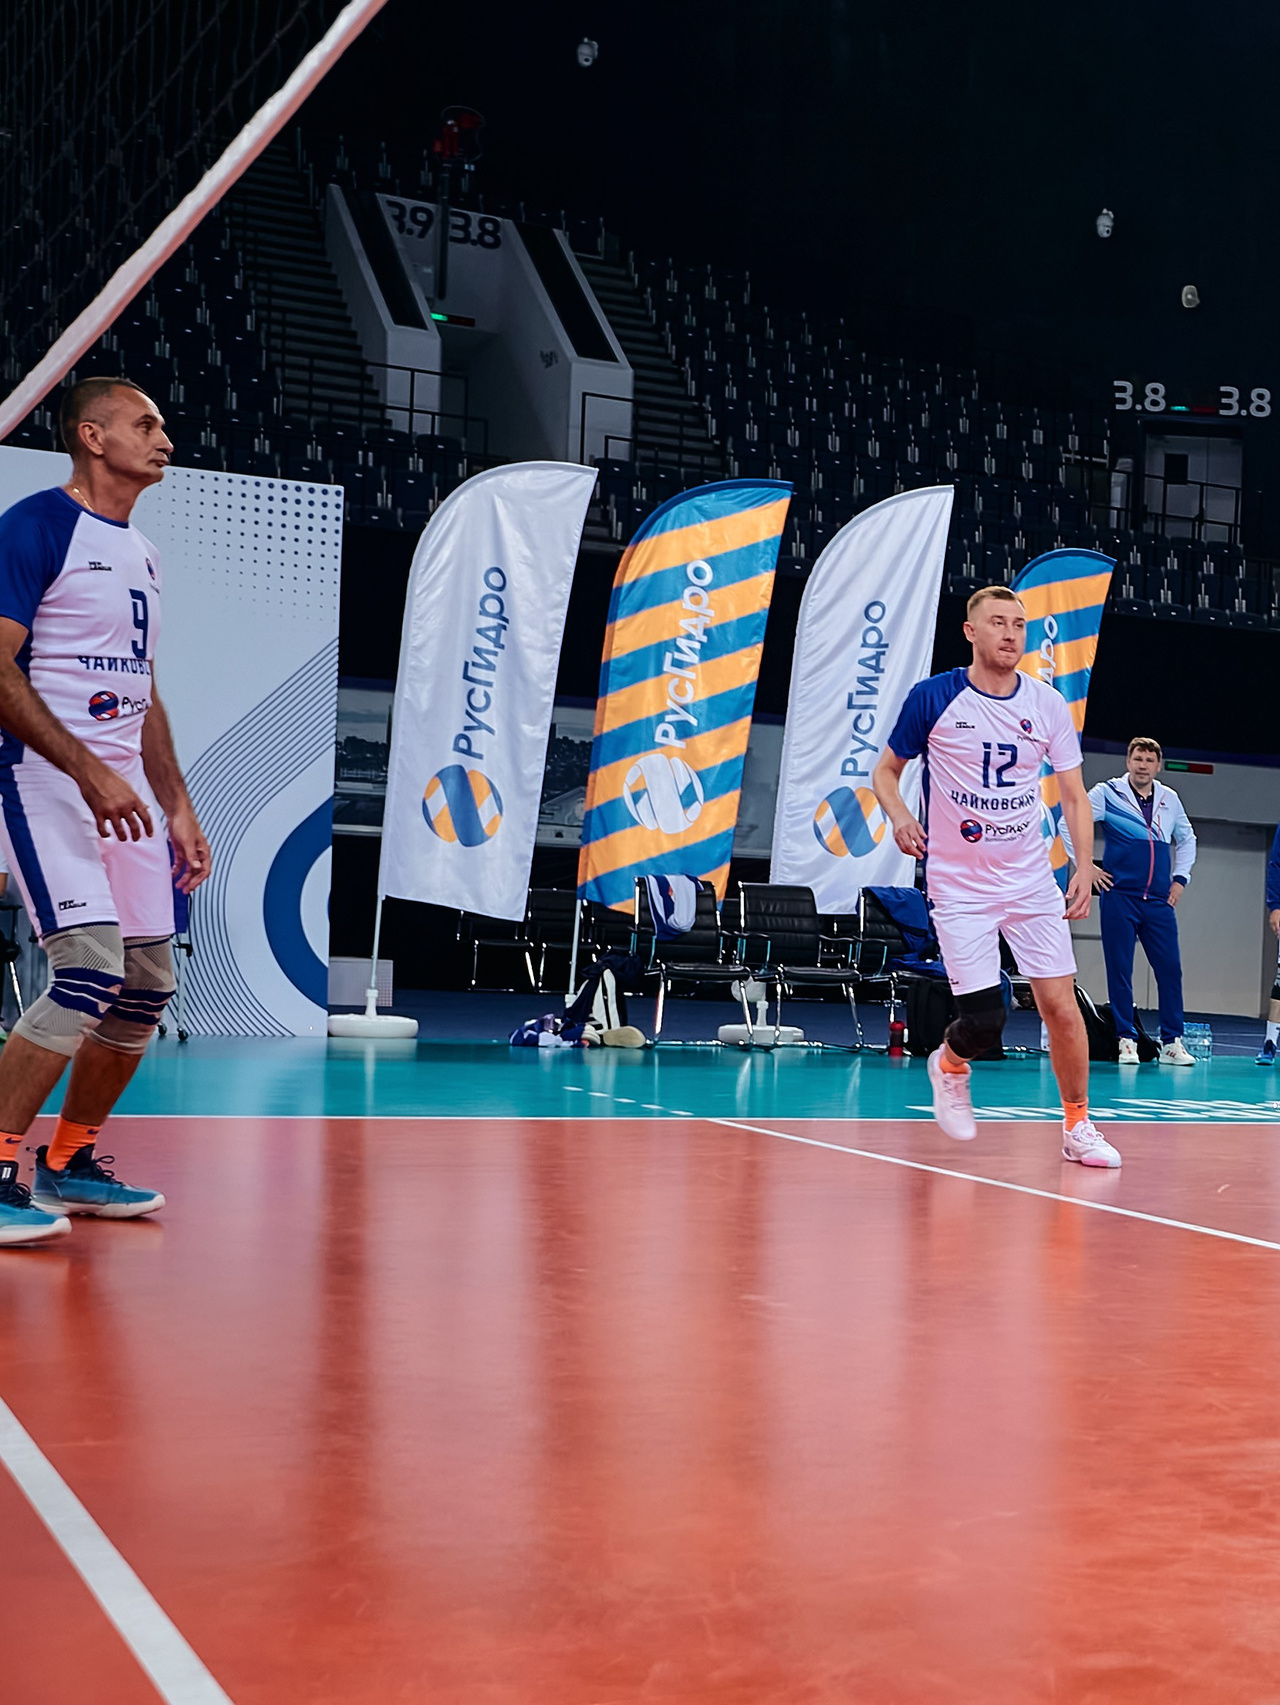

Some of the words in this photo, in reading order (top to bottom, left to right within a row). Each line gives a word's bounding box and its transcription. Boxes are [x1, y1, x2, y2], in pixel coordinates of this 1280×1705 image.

[385, 200, 434, 239] 3.9
[449, 210, 502, 250] 3.8
[1113, 380, 1166, 412] 3.8
[1218, 386, 1272, 418] 3.8
[129, 588, 149, 659] 9
[452, 566, 508, 761] РусГидро
[655, 559, 715, 749] РусГидро
[841, 600, 890, 777] РусГидро
[982, 742, 1018, 788] 12
